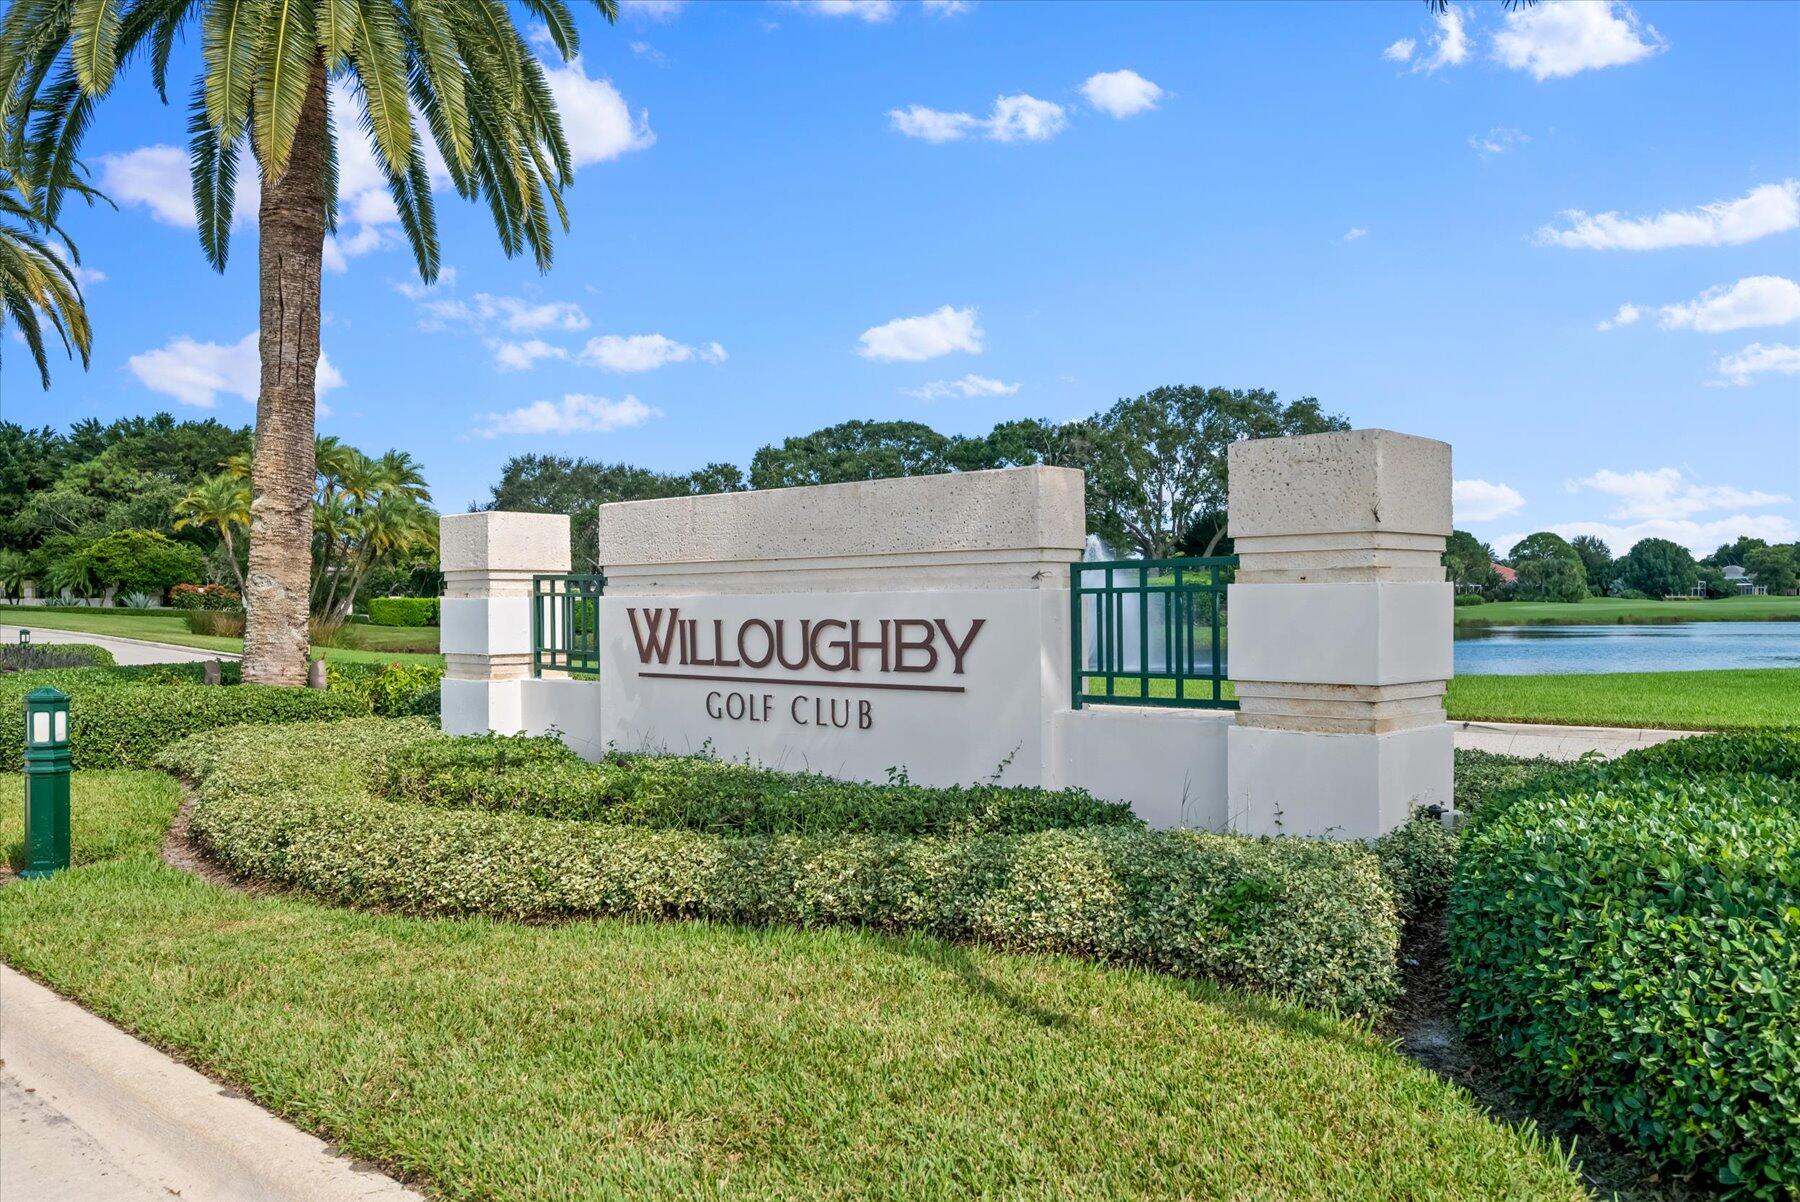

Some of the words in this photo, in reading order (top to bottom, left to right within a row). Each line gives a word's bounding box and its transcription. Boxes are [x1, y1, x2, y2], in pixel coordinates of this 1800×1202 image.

[626, 608, 986, 674] WILLOUGHBY
[706, 691, 773, 722] GOLF
[791, 695, 873, 730] CLUB
